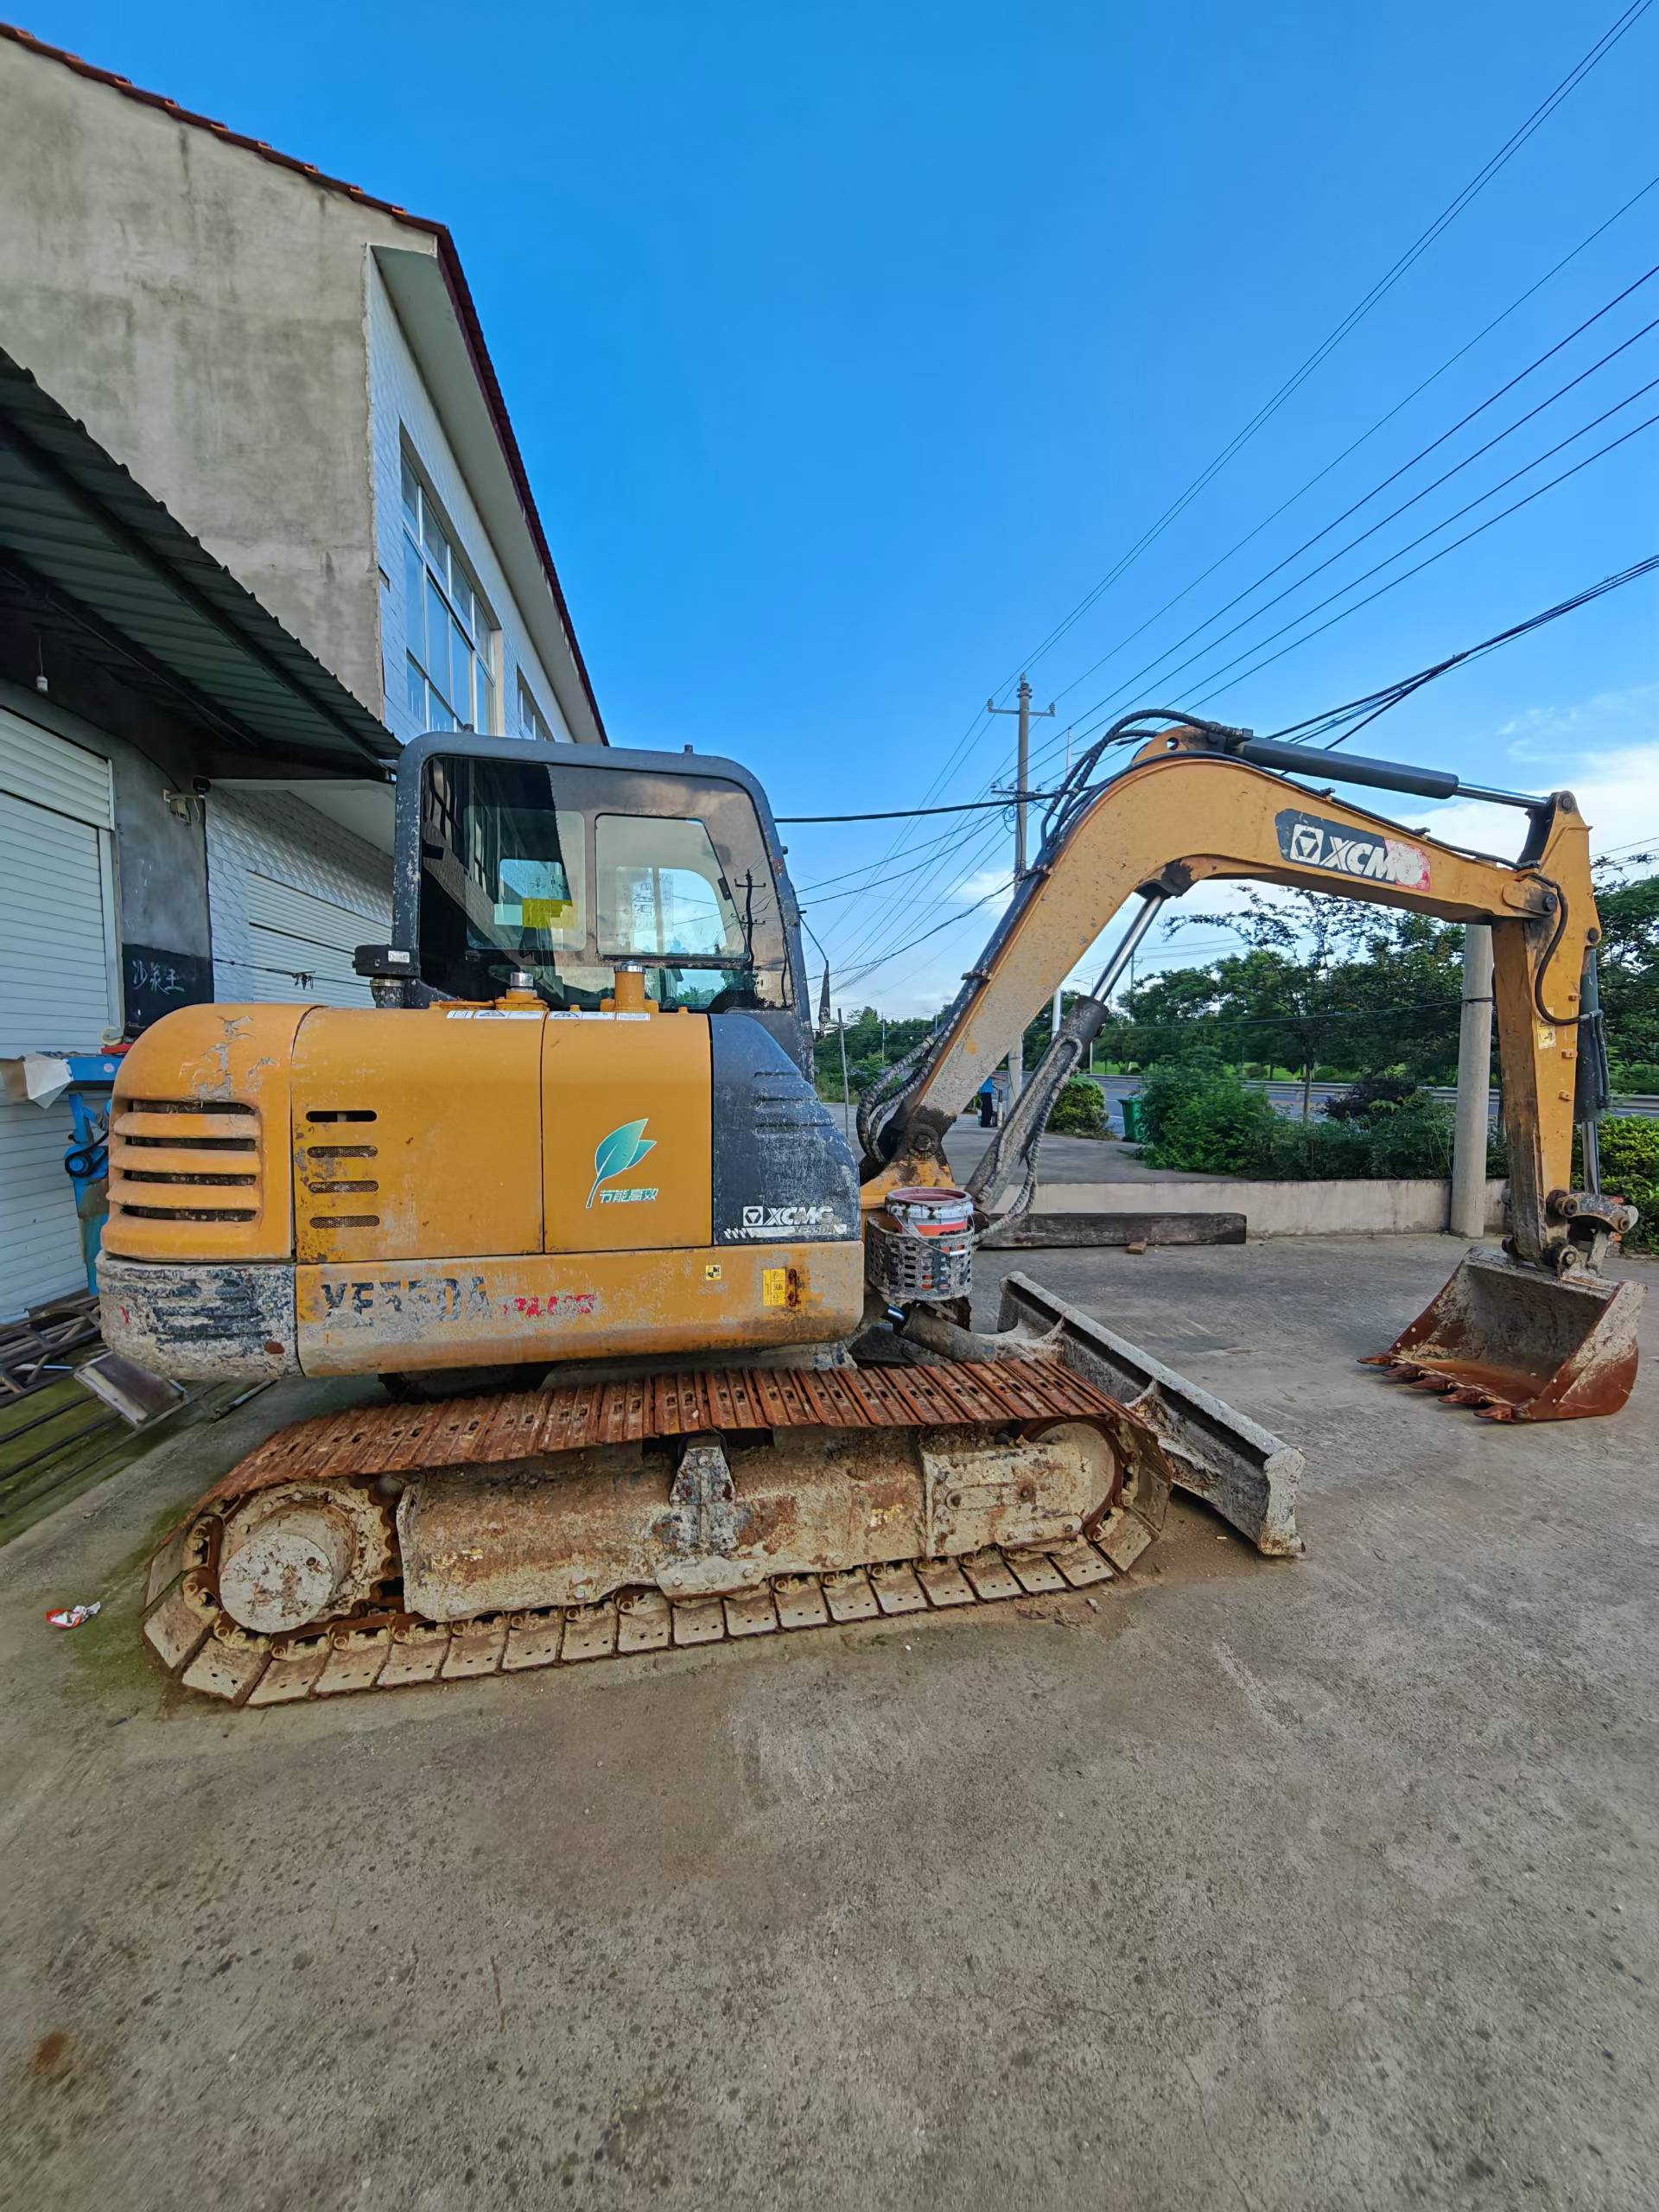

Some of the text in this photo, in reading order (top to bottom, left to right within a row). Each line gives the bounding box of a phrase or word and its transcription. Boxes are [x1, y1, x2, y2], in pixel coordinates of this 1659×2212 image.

[600, 1188, 658, 1203] 节能高效
[763, 1205, 836, 1226] XCMG
